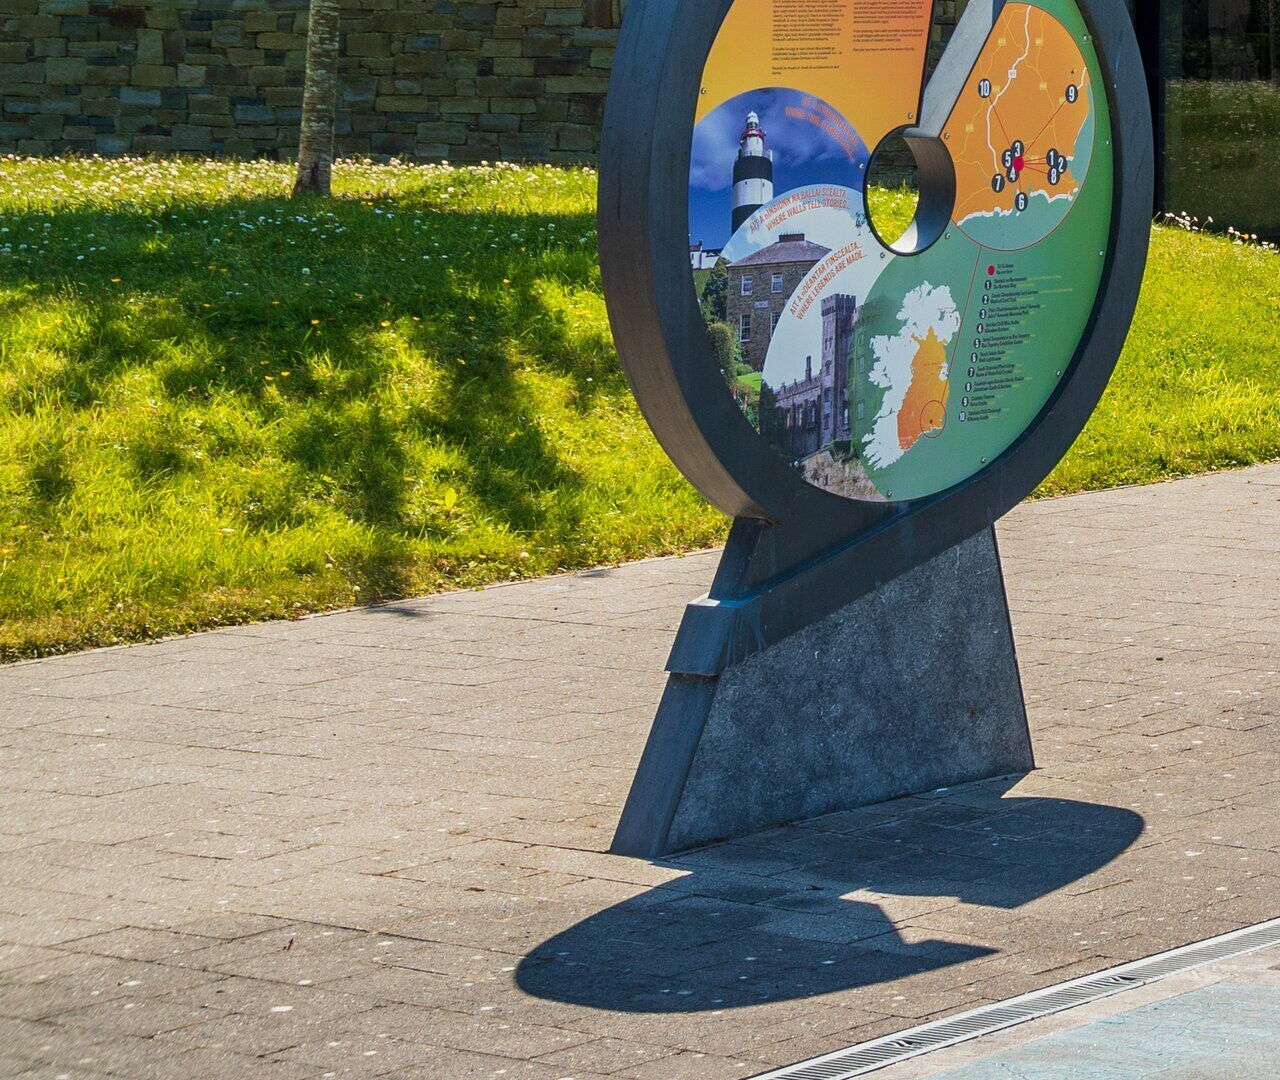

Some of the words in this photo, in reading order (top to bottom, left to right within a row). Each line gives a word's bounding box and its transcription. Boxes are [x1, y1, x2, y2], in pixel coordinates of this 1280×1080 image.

[979, 80, 989, 96] 10
[1068, 88, 1075, 101] 9
[1014, 143, 1020, 156] 3
[1005, 152, 1011, 166] 5
[1058, 159, 1064, 171] 2
[1051, 169, 1057, 183] 8
[995, 178, 1001, 191] 7
[1018, 194, 1025, 209] 6
[766, 212, 787, 231] WHERE
[787, 202, 807, 217] WALLS
[807, 200, 821, 210] TELL
[796, 294, 815, 320] WHERE
[812, 269, 836, 297] LEGENDS
[835, 260, 846, 273] ARE
